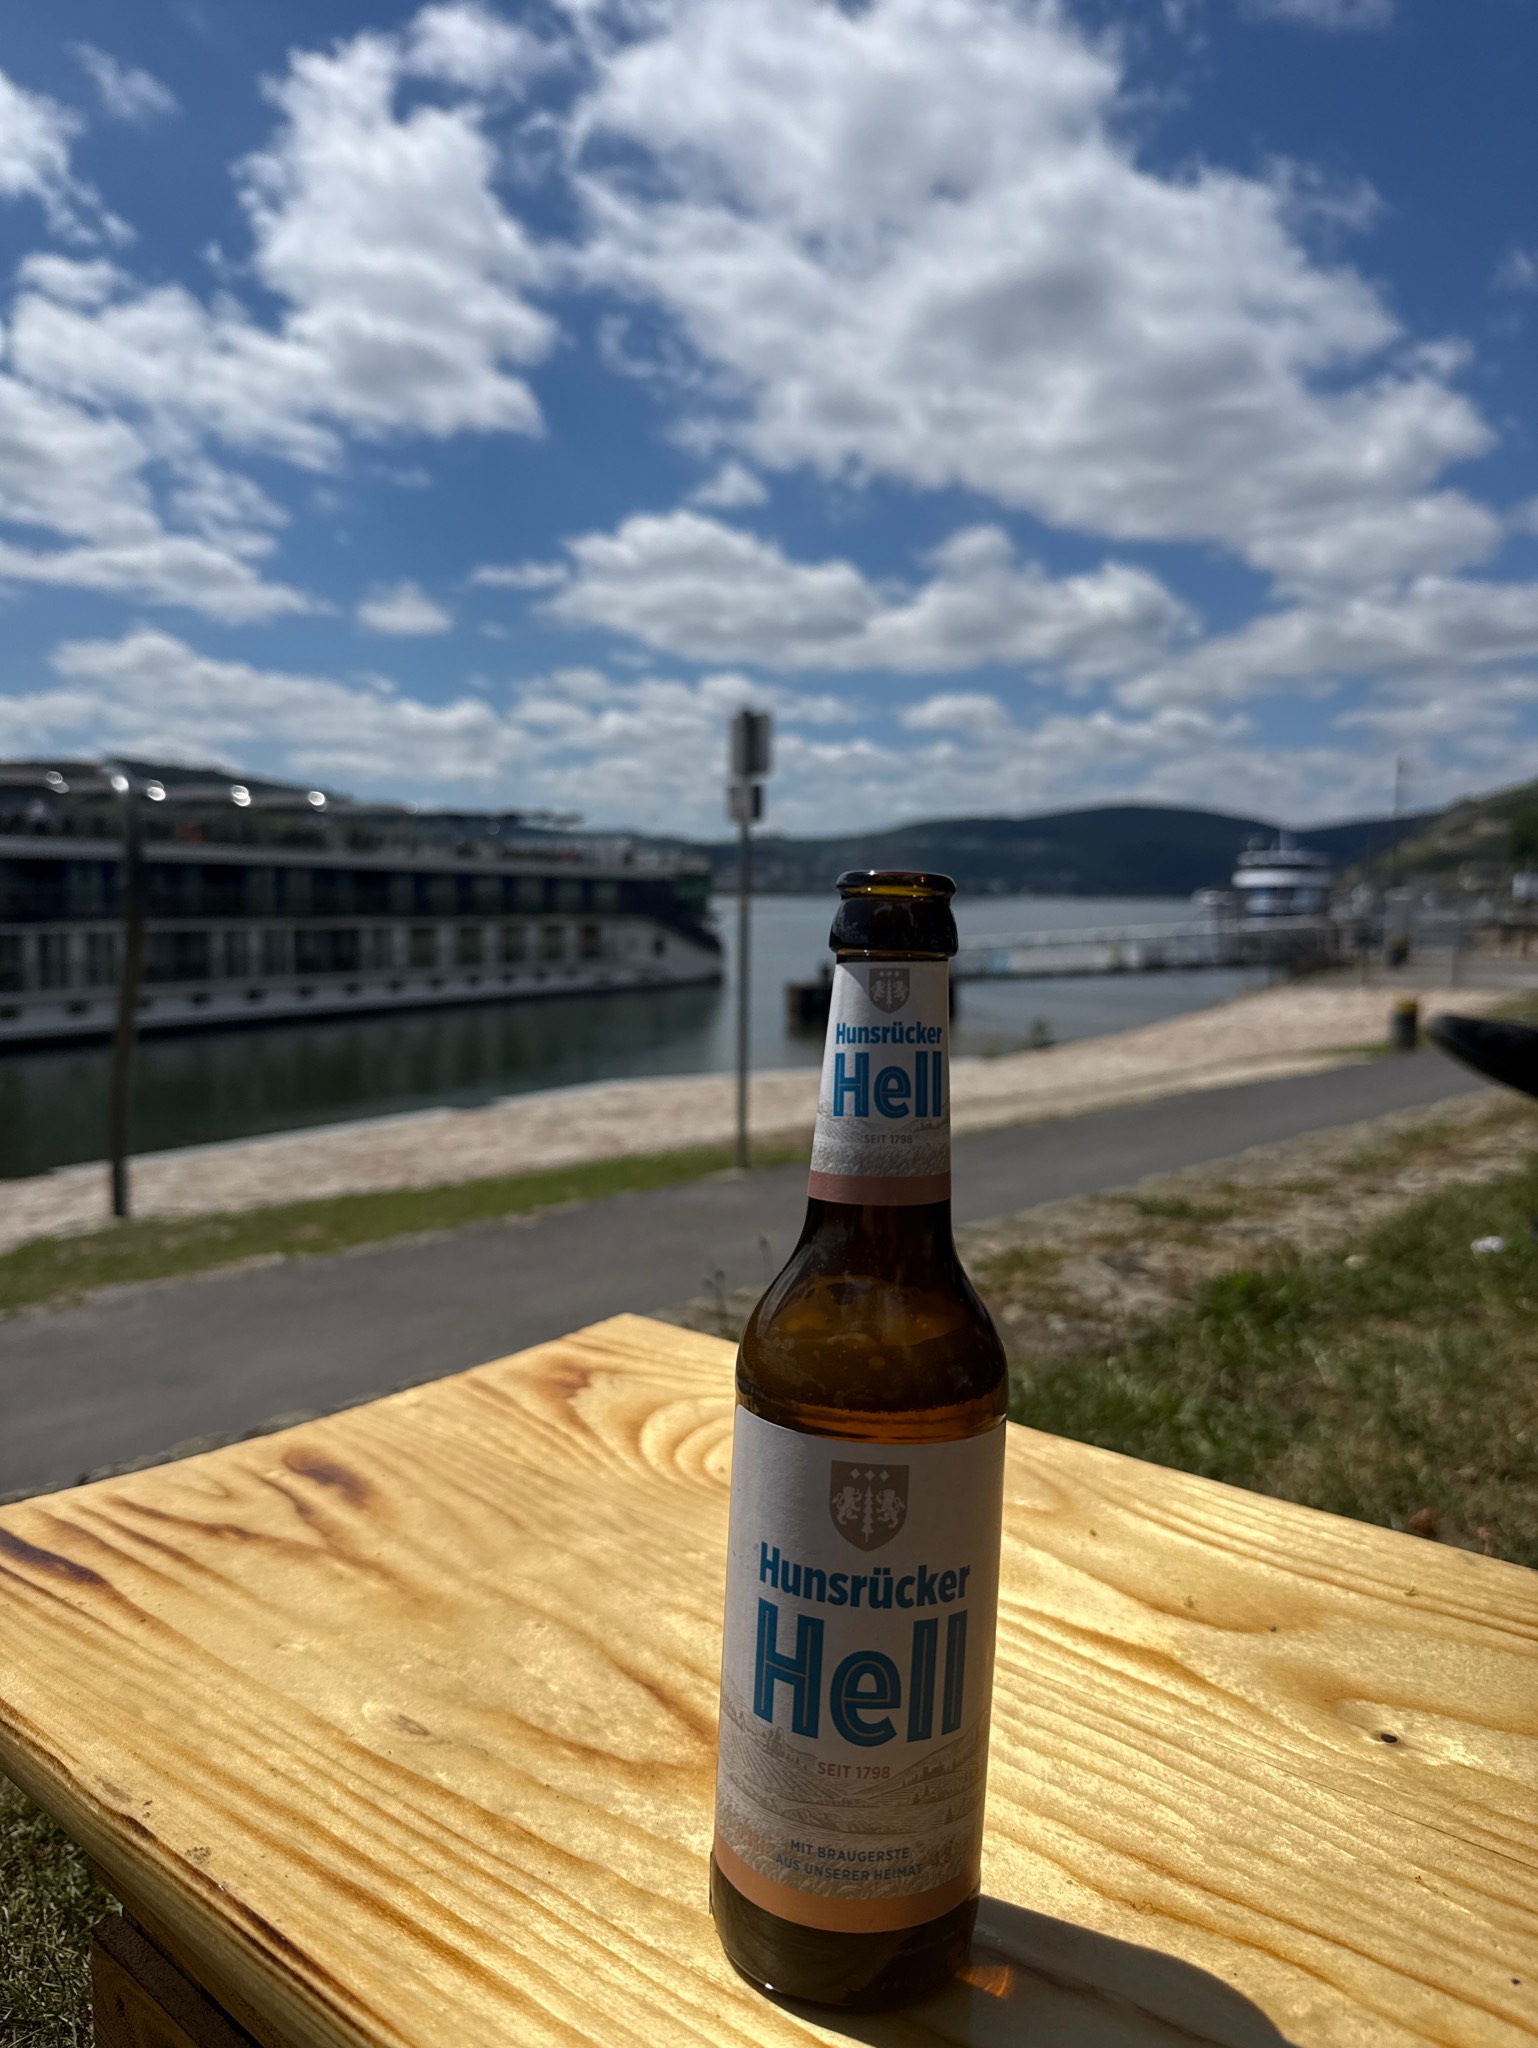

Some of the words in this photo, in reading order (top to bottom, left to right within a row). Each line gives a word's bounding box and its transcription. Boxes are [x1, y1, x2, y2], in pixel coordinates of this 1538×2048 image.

[836, 1022, 942, 1044] Hunsrücker
[833, 1051, 942, 1119] Hell
[864, 1134, 886, 1144] SEIT
[890, 1134, 913, 1144] 1798
[759, 1541, 970, 1609] Hunsrücker
[753, 1597, 968, 1747] Hell
[817, 1761, 851, 1778] SEIT
[855, 1766, 891, 1779] 1798
[790, 1840, 813, 1855] MIT
[817, 1847, 910, 1862] BRAUGERSTE
[775, 1854, 800, 1871] AUS
[804, 1863, 869, 1881] UNSERER
[873, 1863, 923, 1880] HEIMAT
